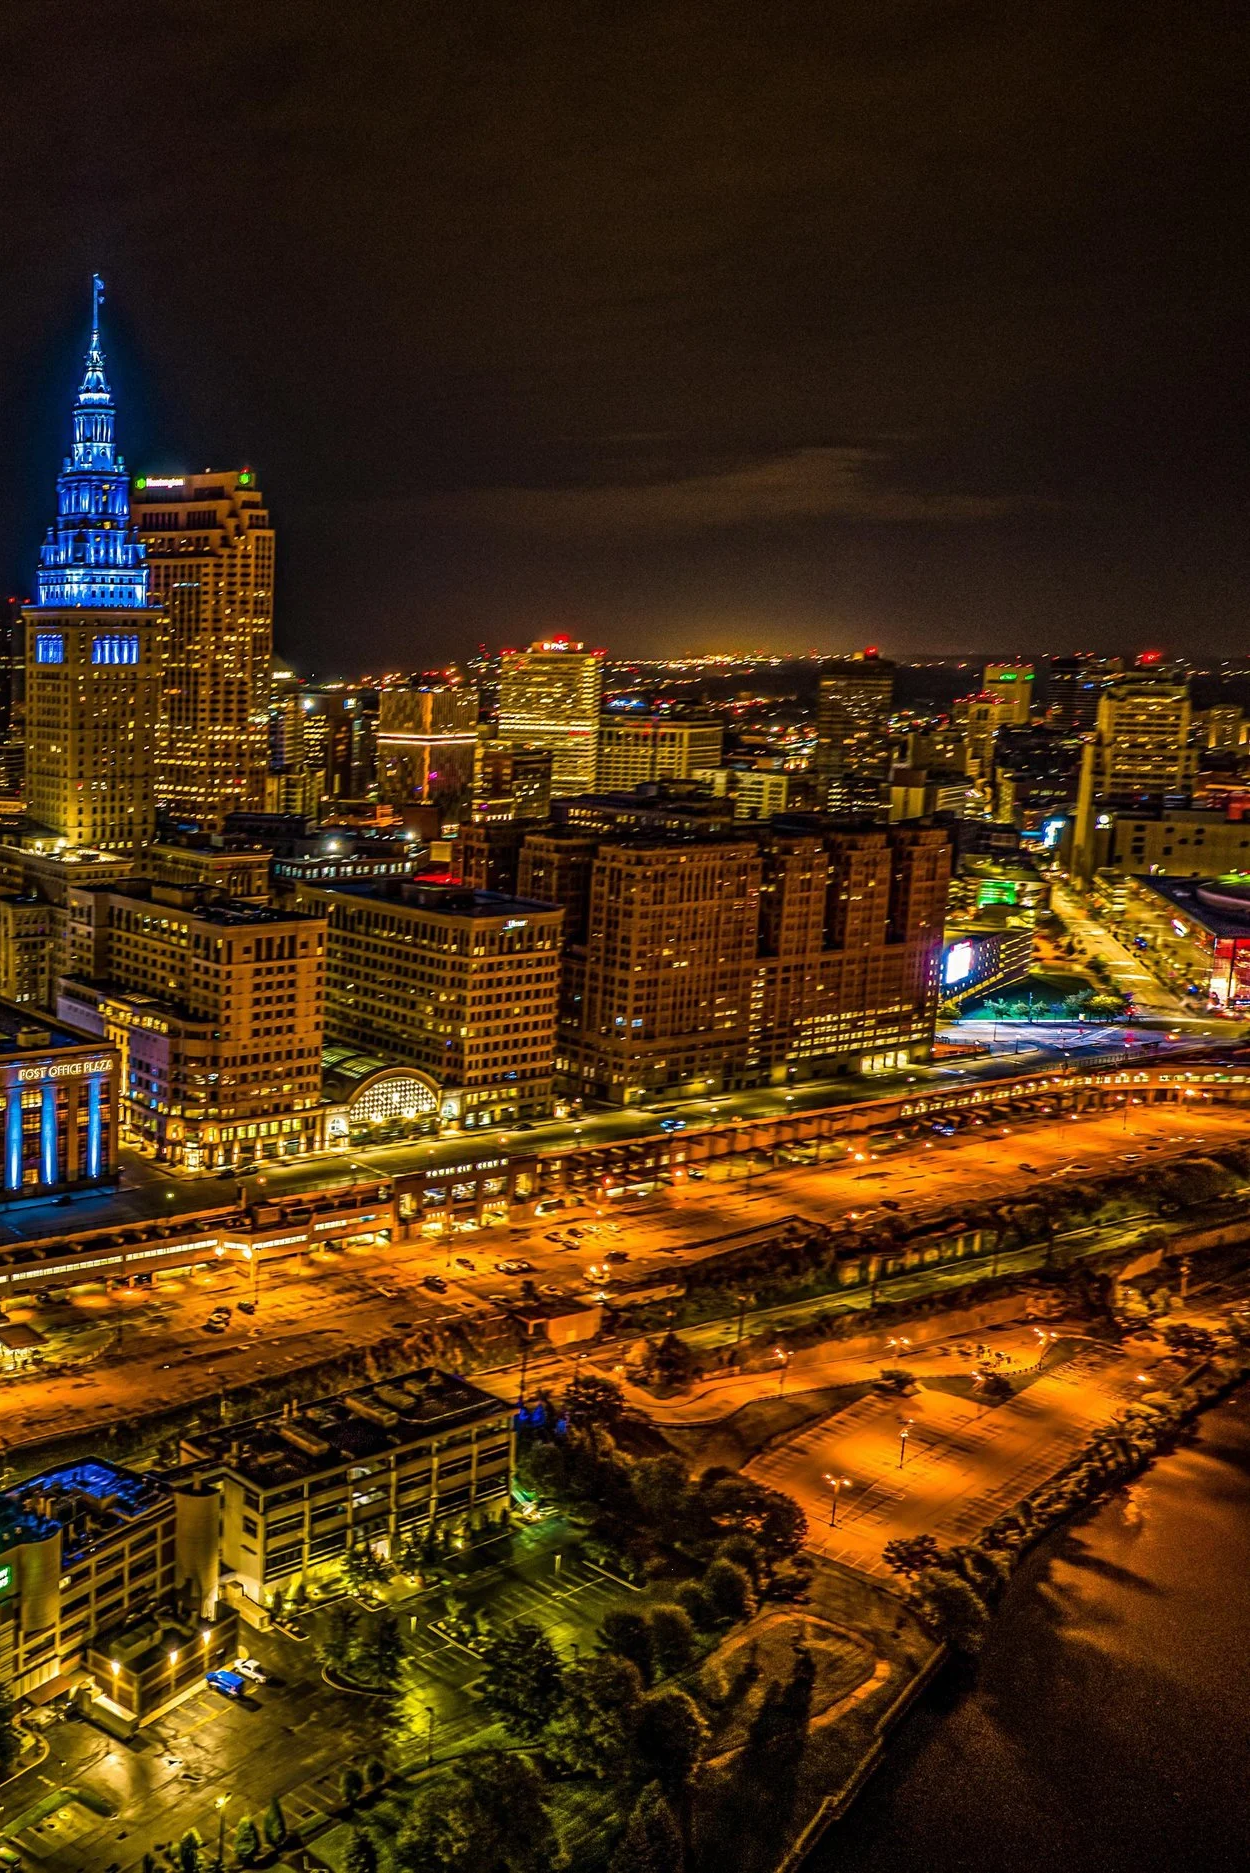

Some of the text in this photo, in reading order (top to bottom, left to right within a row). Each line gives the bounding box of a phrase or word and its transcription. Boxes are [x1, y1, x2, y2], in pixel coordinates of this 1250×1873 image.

[551, 642, 569, 651] PNC
[19, 1060, 113, 1081] POST OFFICE PLAZA
